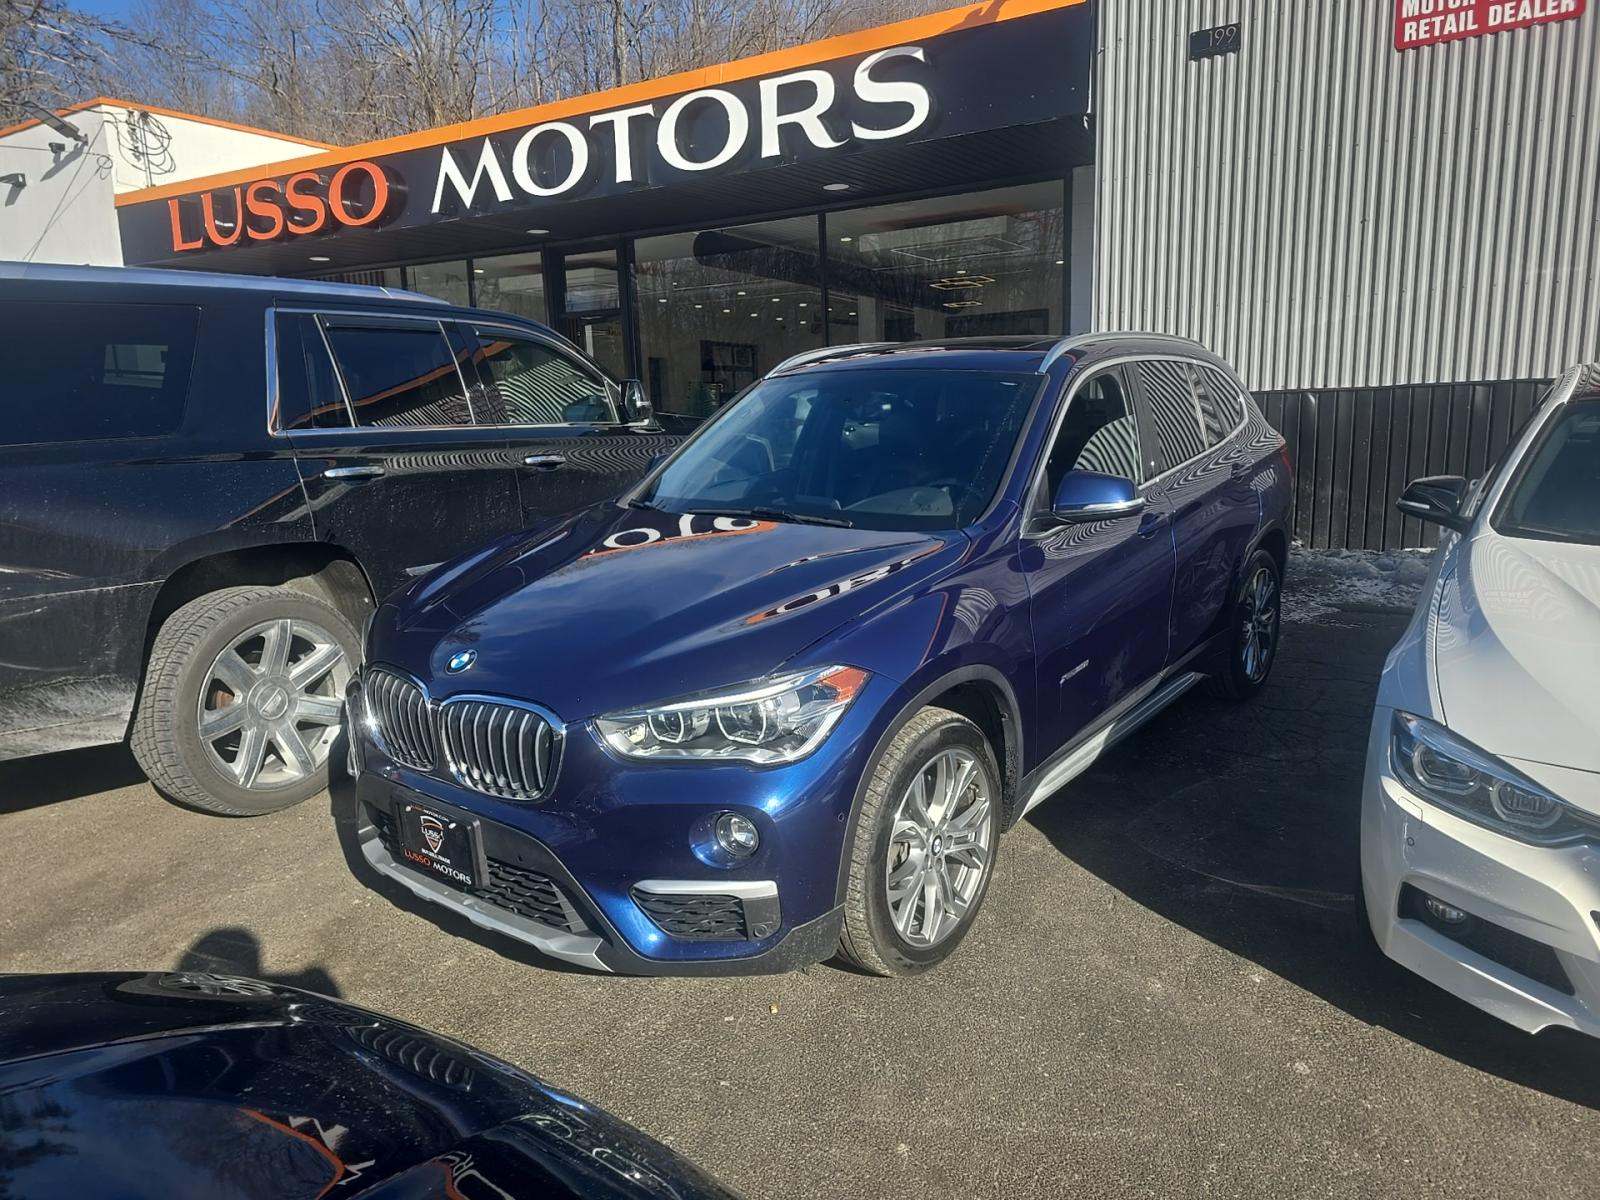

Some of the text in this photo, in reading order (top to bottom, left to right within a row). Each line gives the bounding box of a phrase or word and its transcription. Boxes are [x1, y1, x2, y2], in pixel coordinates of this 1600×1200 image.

[1208, 26, 1237, 47] 199
[1403, 0, 1576, 43] RETAIL DEALER
[167, 46, 931, 253] LUSSO MOTORS
[404, 848, 431, 866] LUSSO
[433, 862, 472, 884] MOTORS
